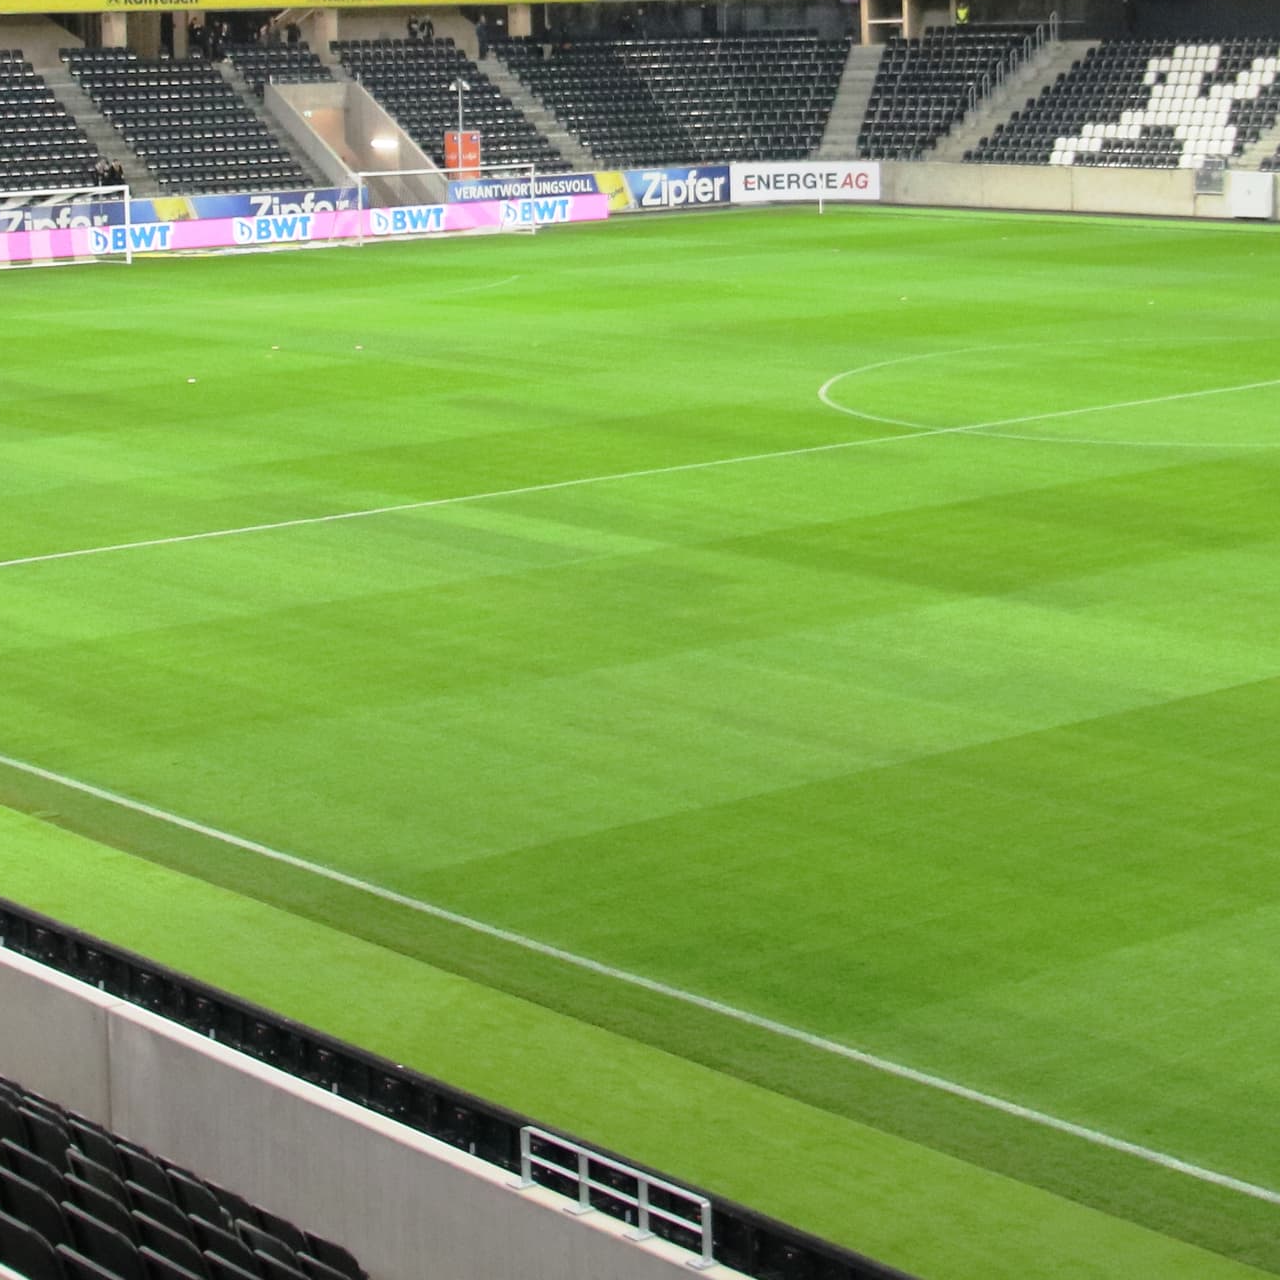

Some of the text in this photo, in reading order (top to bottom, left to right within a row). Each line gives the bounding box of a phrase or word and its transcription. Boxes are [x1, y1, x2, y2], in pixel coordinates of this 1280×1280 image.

[641, 170, 726, 207] Zipfer
[840, 172, 870, 190] AG
[392, 208, 444, 232] BWT
[521, 199, 569, 222] BWT
[112, 225, 171, 252] BWT
[256, 215, 311, 240] BWT
